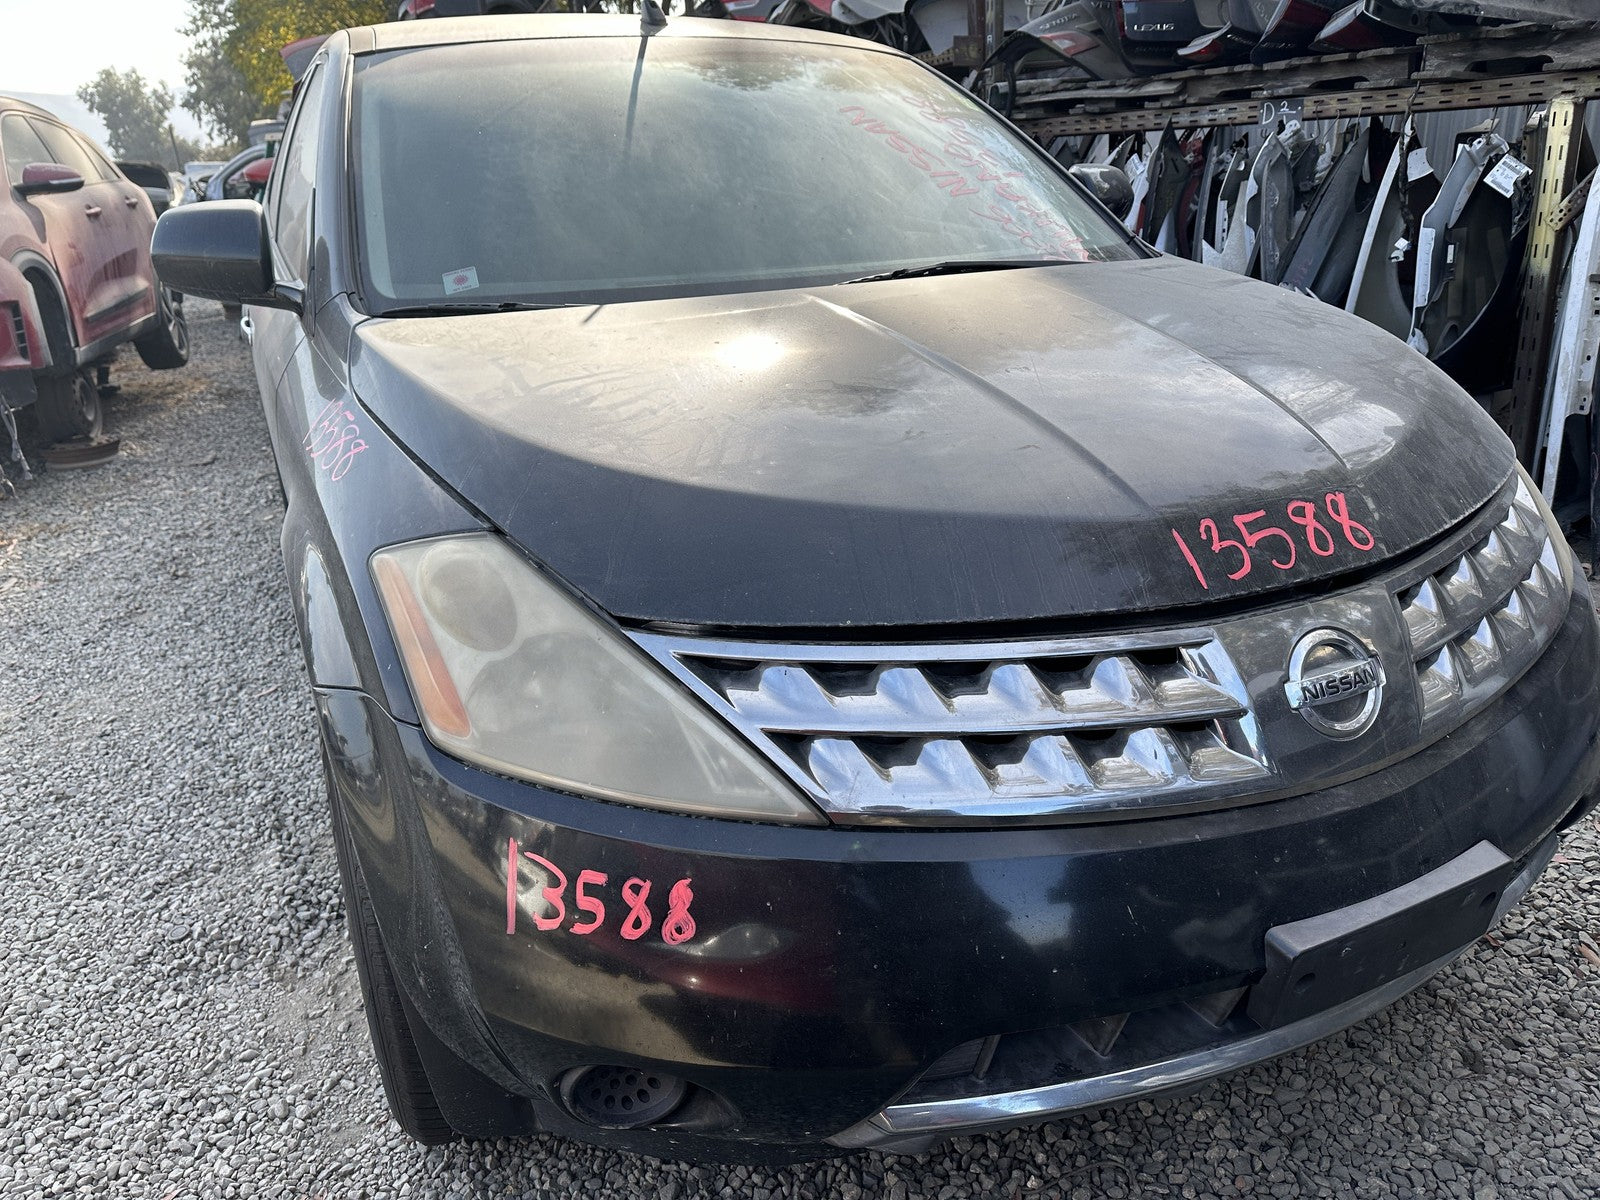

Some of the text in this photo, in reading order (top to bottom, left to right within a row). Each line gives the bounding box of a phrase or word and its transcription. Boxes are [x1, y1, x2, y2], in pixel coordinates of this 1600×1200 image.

[1133, 23, 1176, 33] LEXUS
[1262, 101, 1275, 125] D
[839, 105, 980, 197] NISSAN
[1171, 491, 1376, 590] 13588
[1301, 664, 1376, 703] NISSAN
[506, 837, 697, 946] 13588
